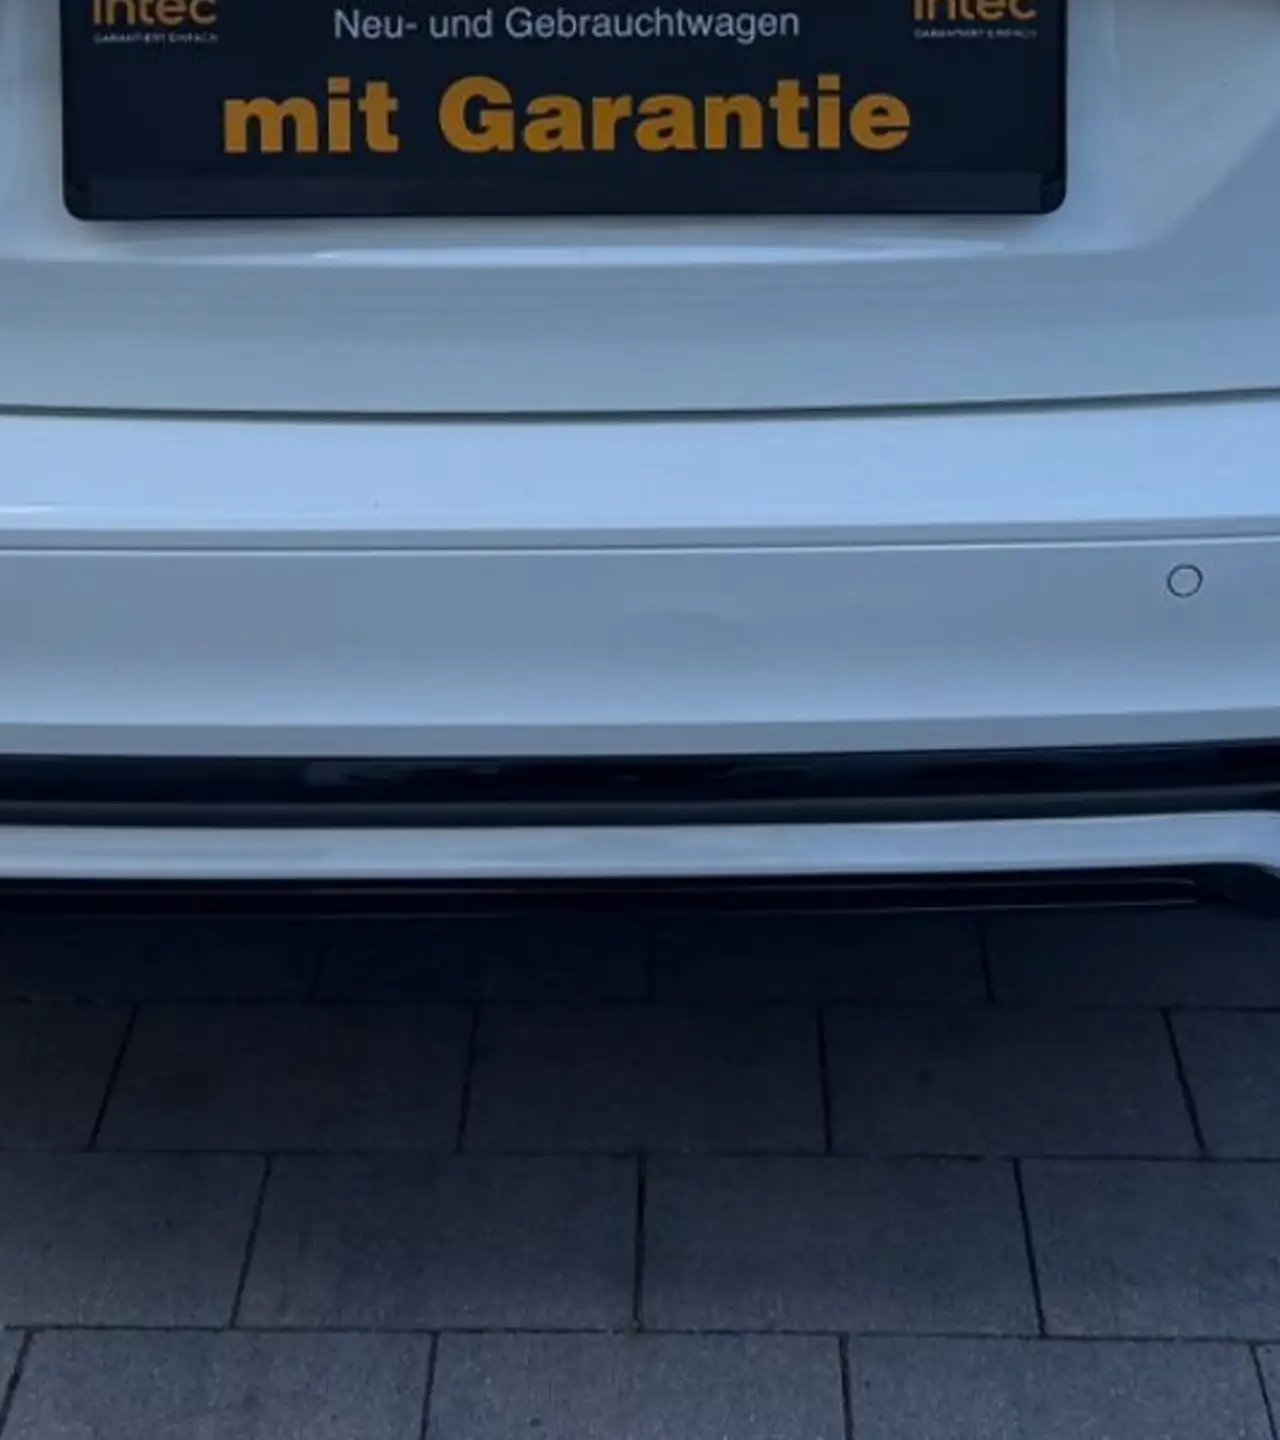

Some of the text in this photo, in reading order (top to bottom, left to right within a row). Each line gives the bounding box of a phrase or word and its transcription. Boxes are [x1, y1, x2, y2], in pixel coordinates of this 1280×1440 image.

[333, 6, 800, 45] Neu- und Gebrauchtwagen
[223, 74, 911, 153] mit Garantie
